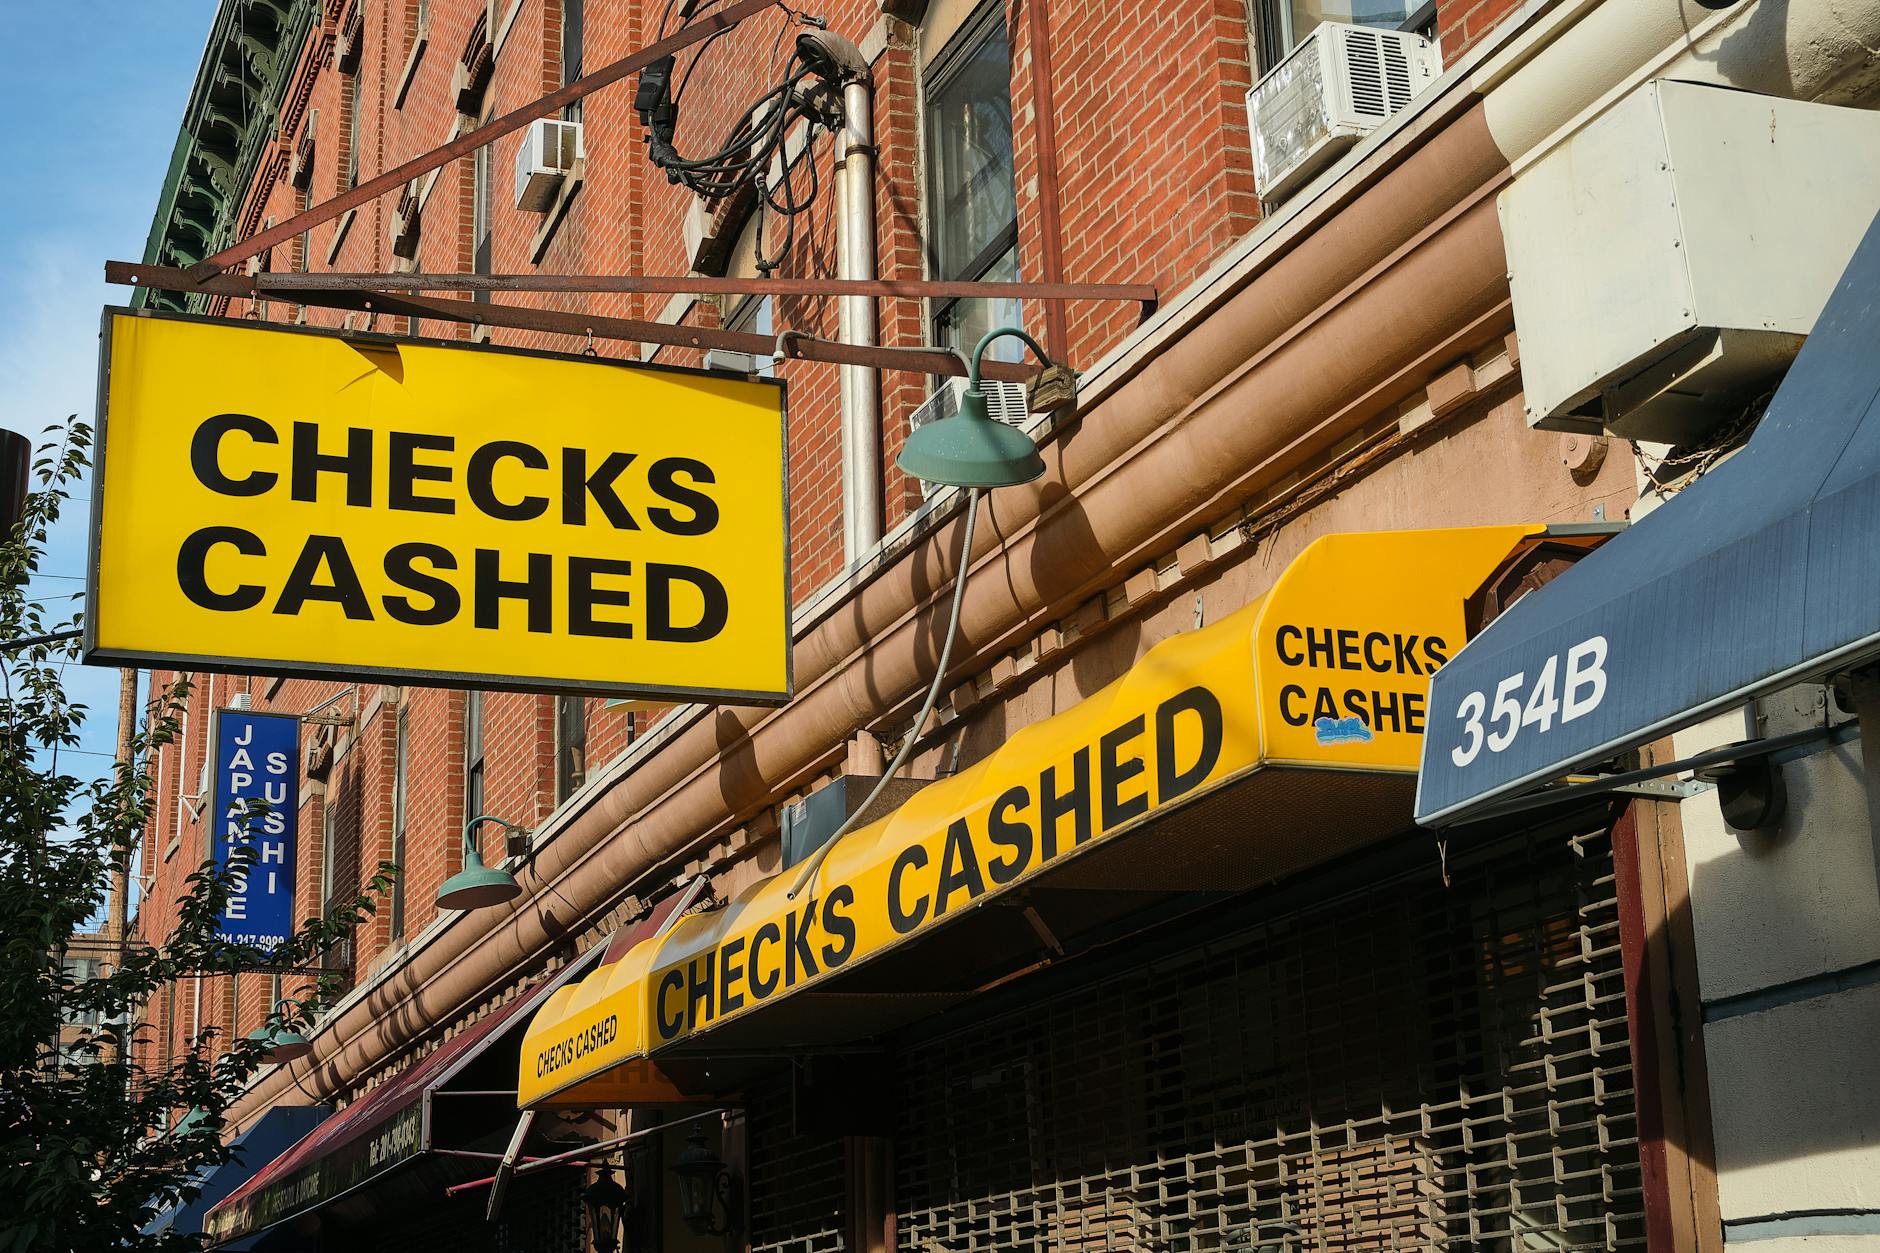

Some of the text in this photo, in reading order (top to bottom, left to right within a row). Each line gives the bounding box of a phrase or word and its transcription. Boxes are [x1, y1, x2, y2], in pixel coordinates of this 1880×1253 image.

[189, 413, 720, 537] CHECKS
[176, 526, 729, 644] CASHED
[1275, 624, 1448, 676] CHECKS
[1279, 684, 1425, 735] CASHE
[1451, 635, 1609, 768] 354B
[262, 752, 288, 895] SUSHI
[656, 685, 1223, 1040] CHECKS CASHED
[537, 1037, 574, 1078] CHECKS
[576, 1014, 618, 1059] CASHED
